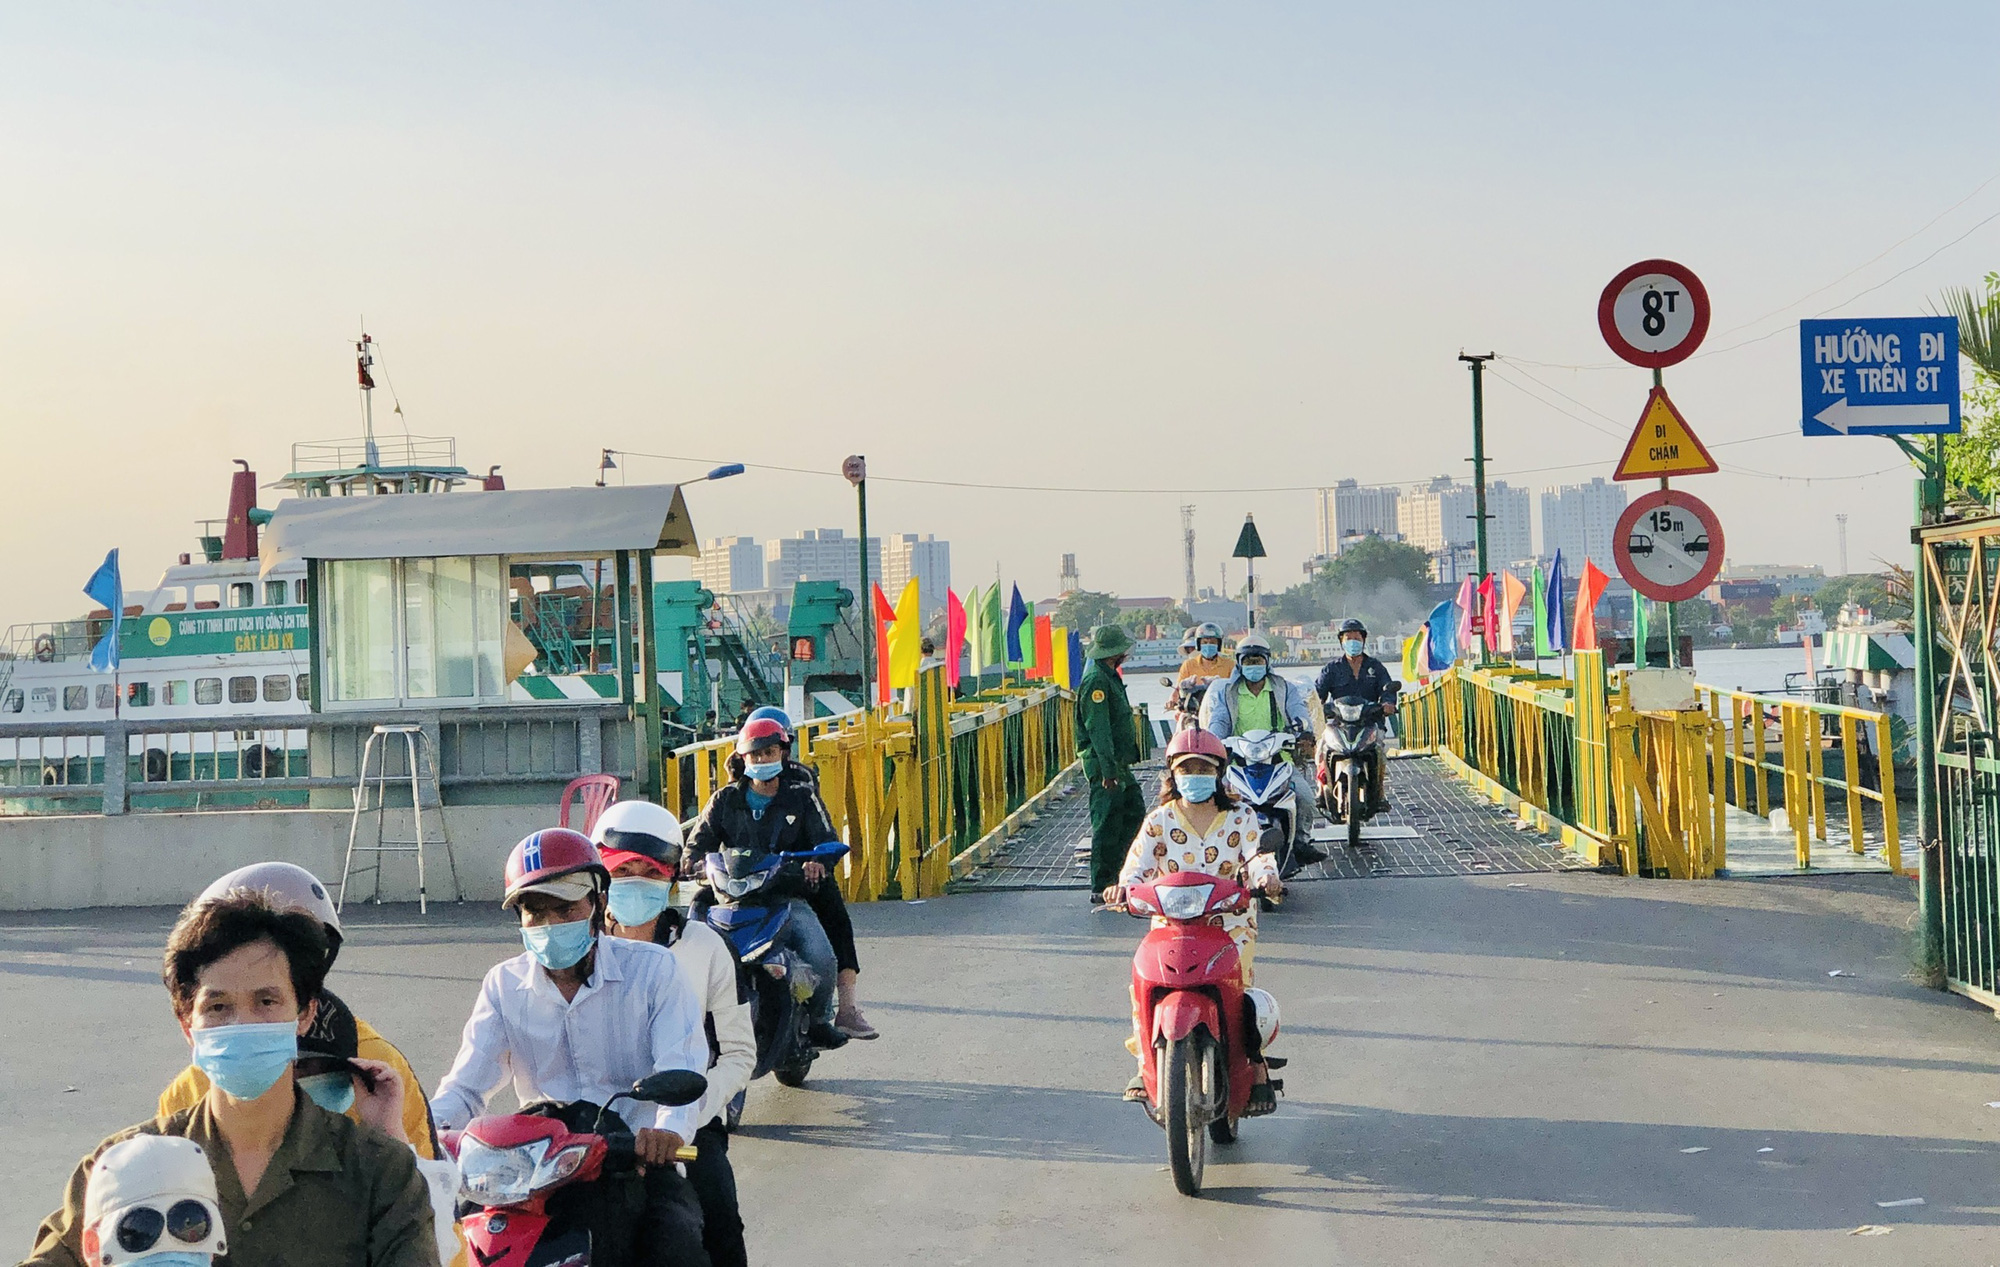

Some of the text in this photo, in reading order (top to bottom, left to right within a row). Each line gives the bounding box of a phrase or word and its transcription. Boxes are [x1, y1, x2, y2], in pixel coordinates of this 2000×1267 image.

[1642, 290, 1679, 336] 8T
[1814, 326, 1945, 364] HƯỚNG ĐI
[1821, 362, 1941, 394] XE TRÊN 8T
[1655, 424, 1666, 438] ĐI
[1649, 511, 1684, 532] 15m
[179, 617, 196, 635] CÔNG
[197, 619, 205, 634] TY
